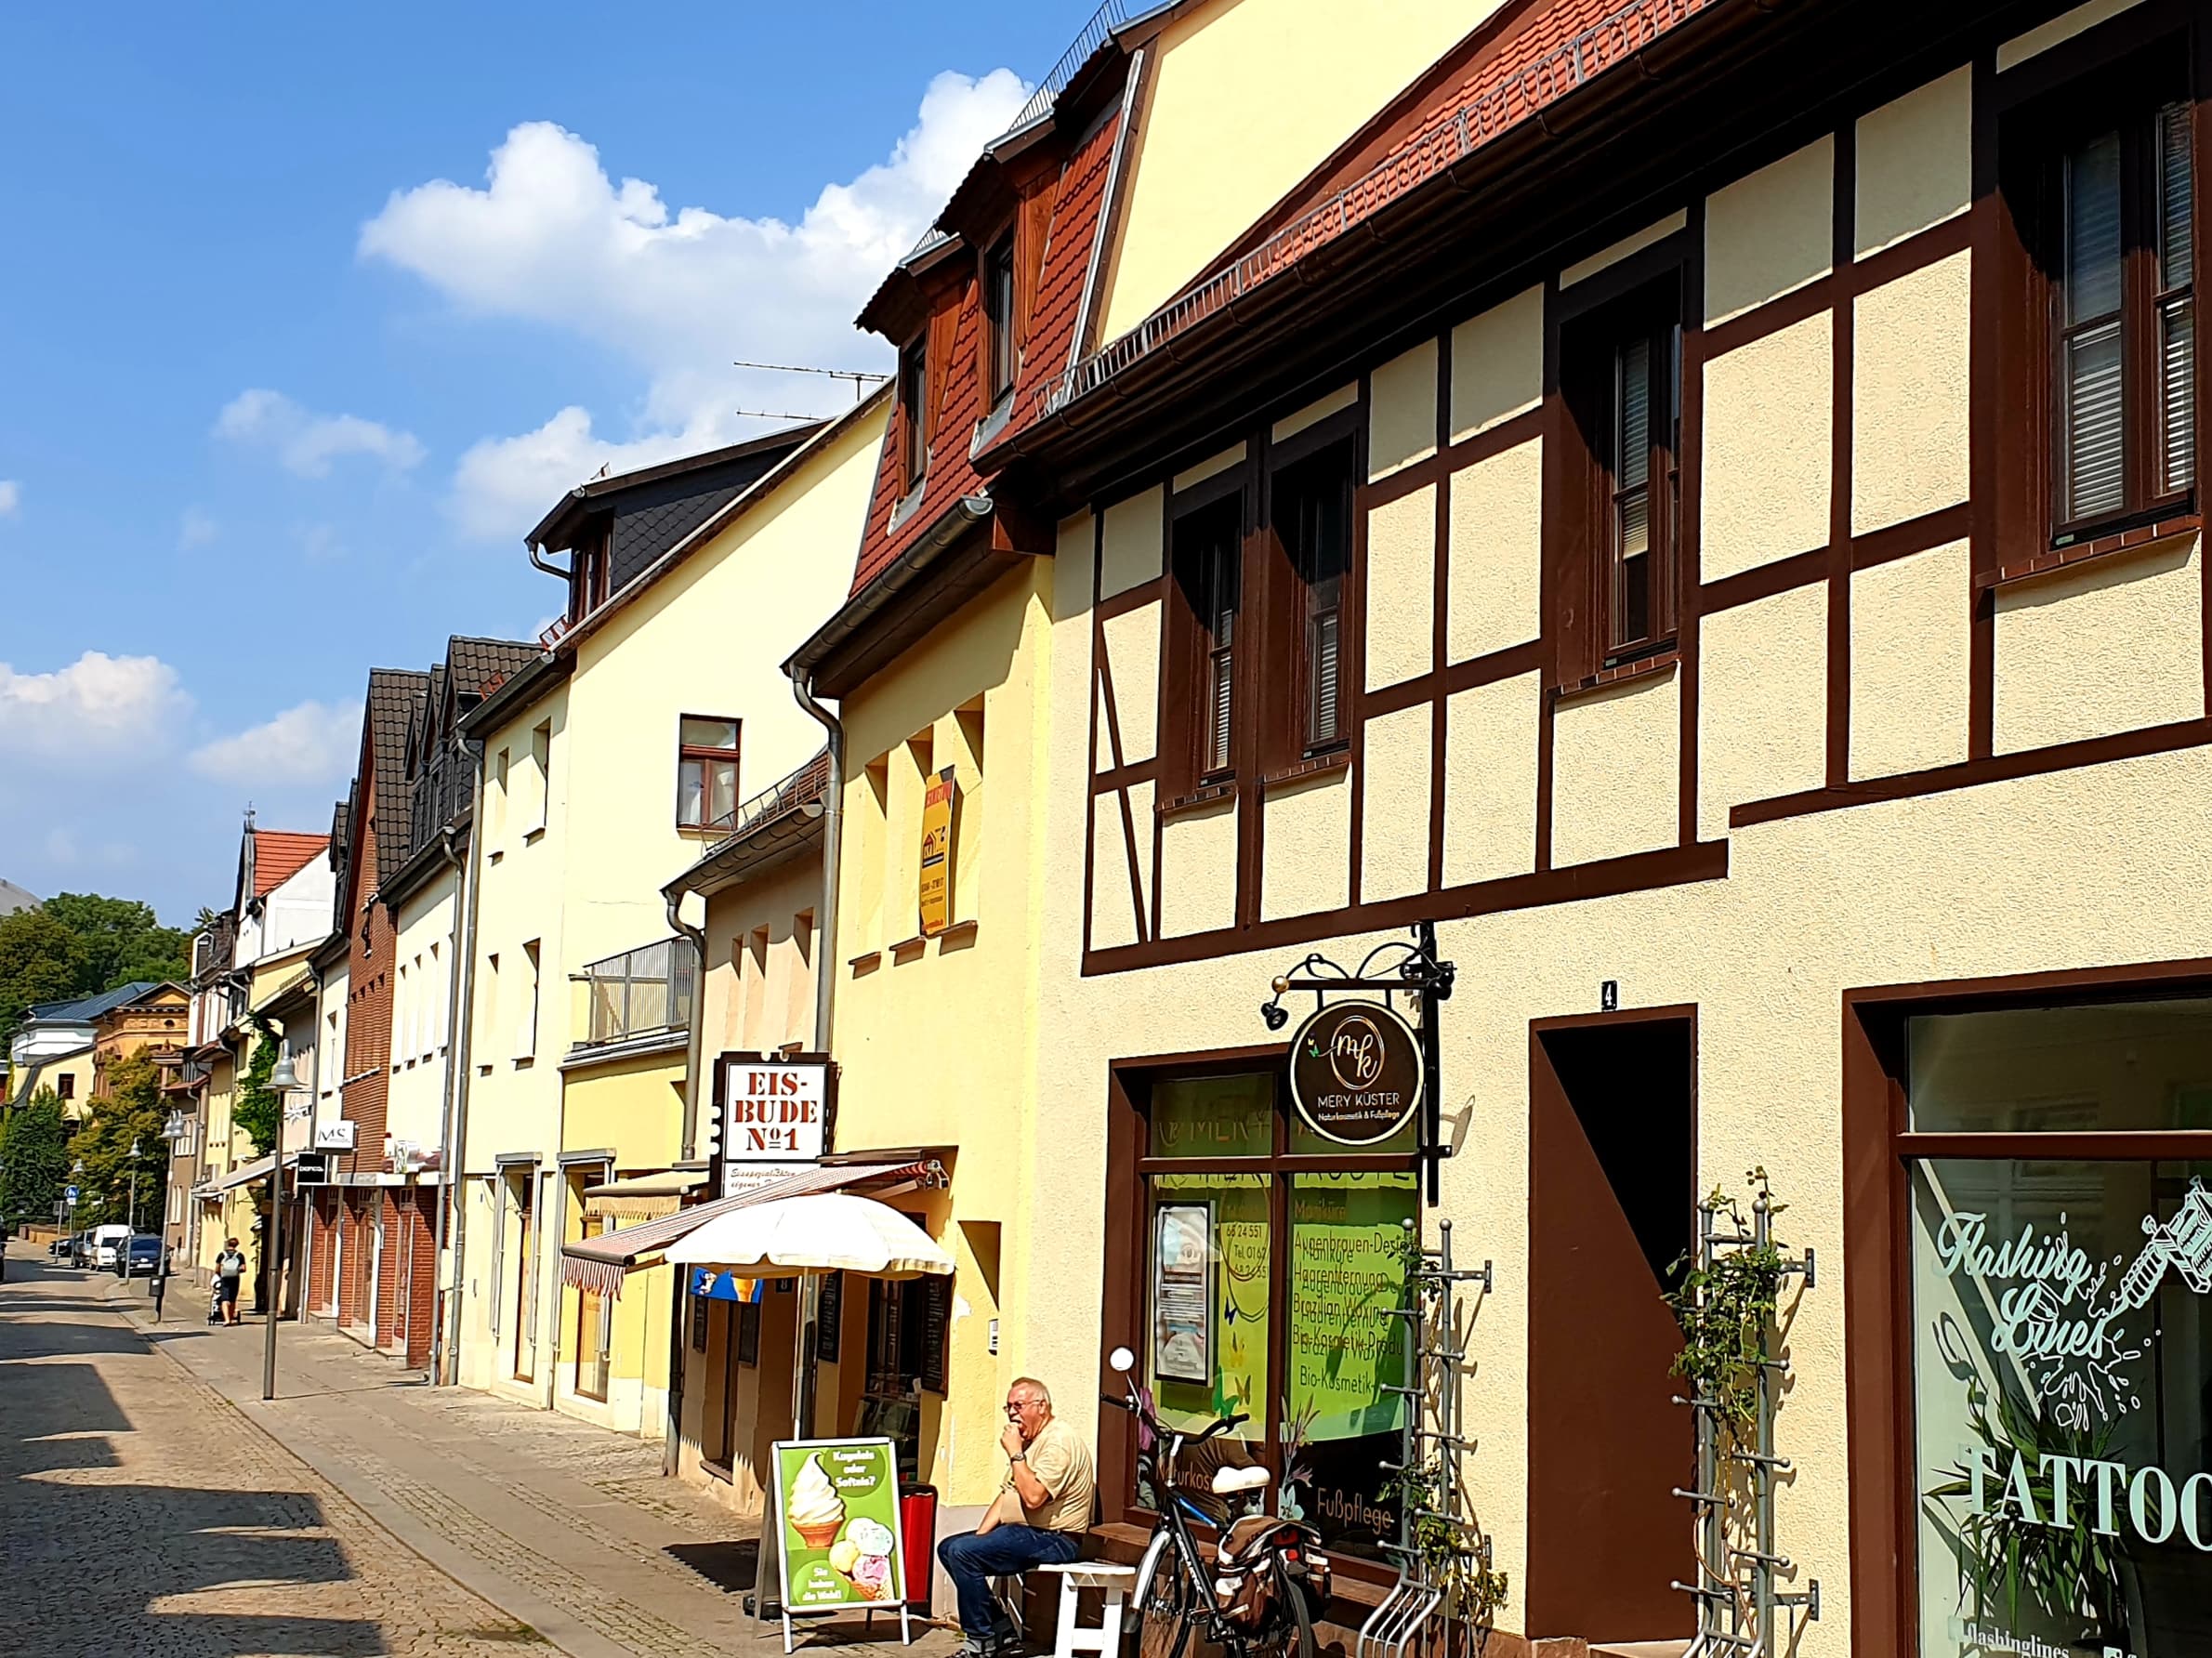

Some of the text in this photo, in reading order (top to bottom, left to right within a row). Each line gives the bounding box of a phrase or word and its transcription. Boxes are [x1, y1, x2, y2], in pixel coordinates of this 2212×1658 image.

[1604, 983, 1613, 1007] 4
[747, 1072, 809, 1096] EIS-
[733, 1099, 818, 1124] BUDE
[1317, 1091, 1400, 1109] MERY KÜSTER
[1933, 1211, 2092, 1306] Flashing
[1991, 1282, 2108, 1359] Lines
[1317, 1487, 1392, 1535] Fußpflege
